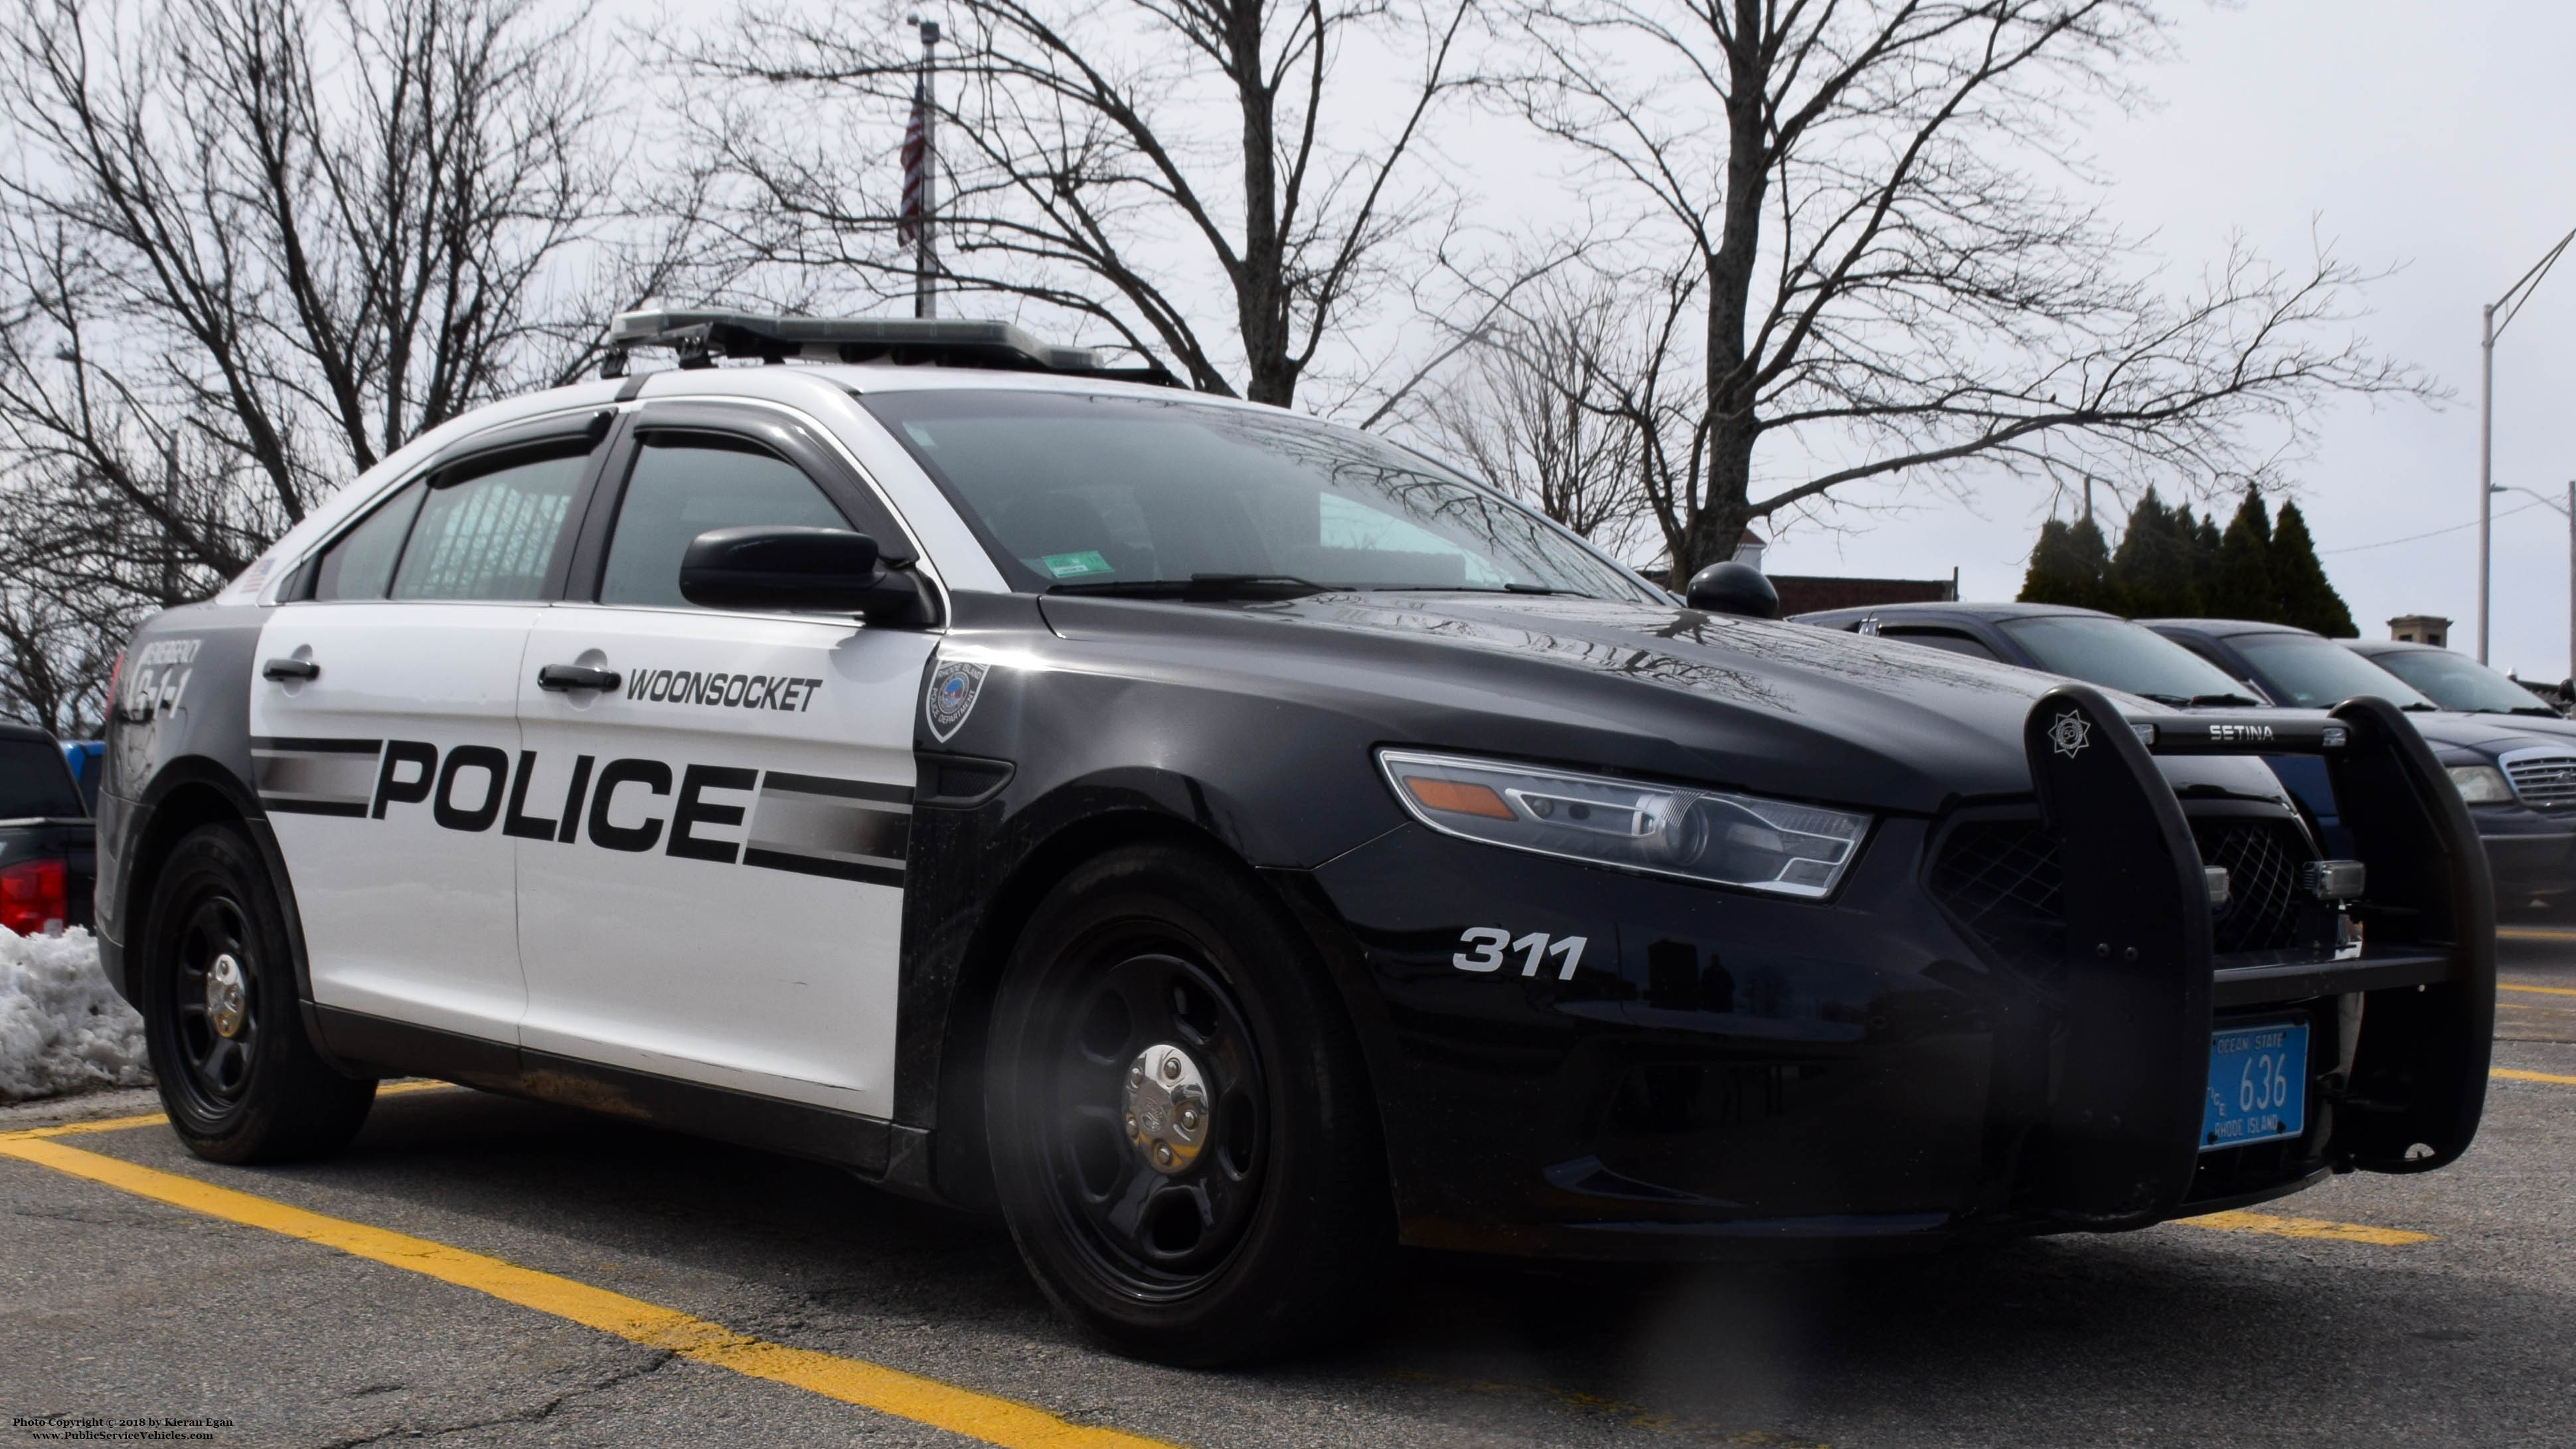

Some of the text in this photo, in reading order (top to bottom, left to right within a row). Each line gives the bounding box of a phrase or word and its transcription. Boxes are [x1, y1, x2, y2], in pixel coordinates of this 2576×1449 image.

[627, 668, 824, 713] WOONSOCKET
[931, 687, 975, 724] POLICE DEPARTMENT
[2209, 724, 2275, 741] SETINA
[372, 739, 759, 864] POLICE
[1452, 926, 1588, 981] 311
[2217, 1033, 2284, 1054] OCEAN STATE
[2239, 1053, 2287, 1113] 636
[2214, 1114, 2278, 1138] RHODE ISLAND
